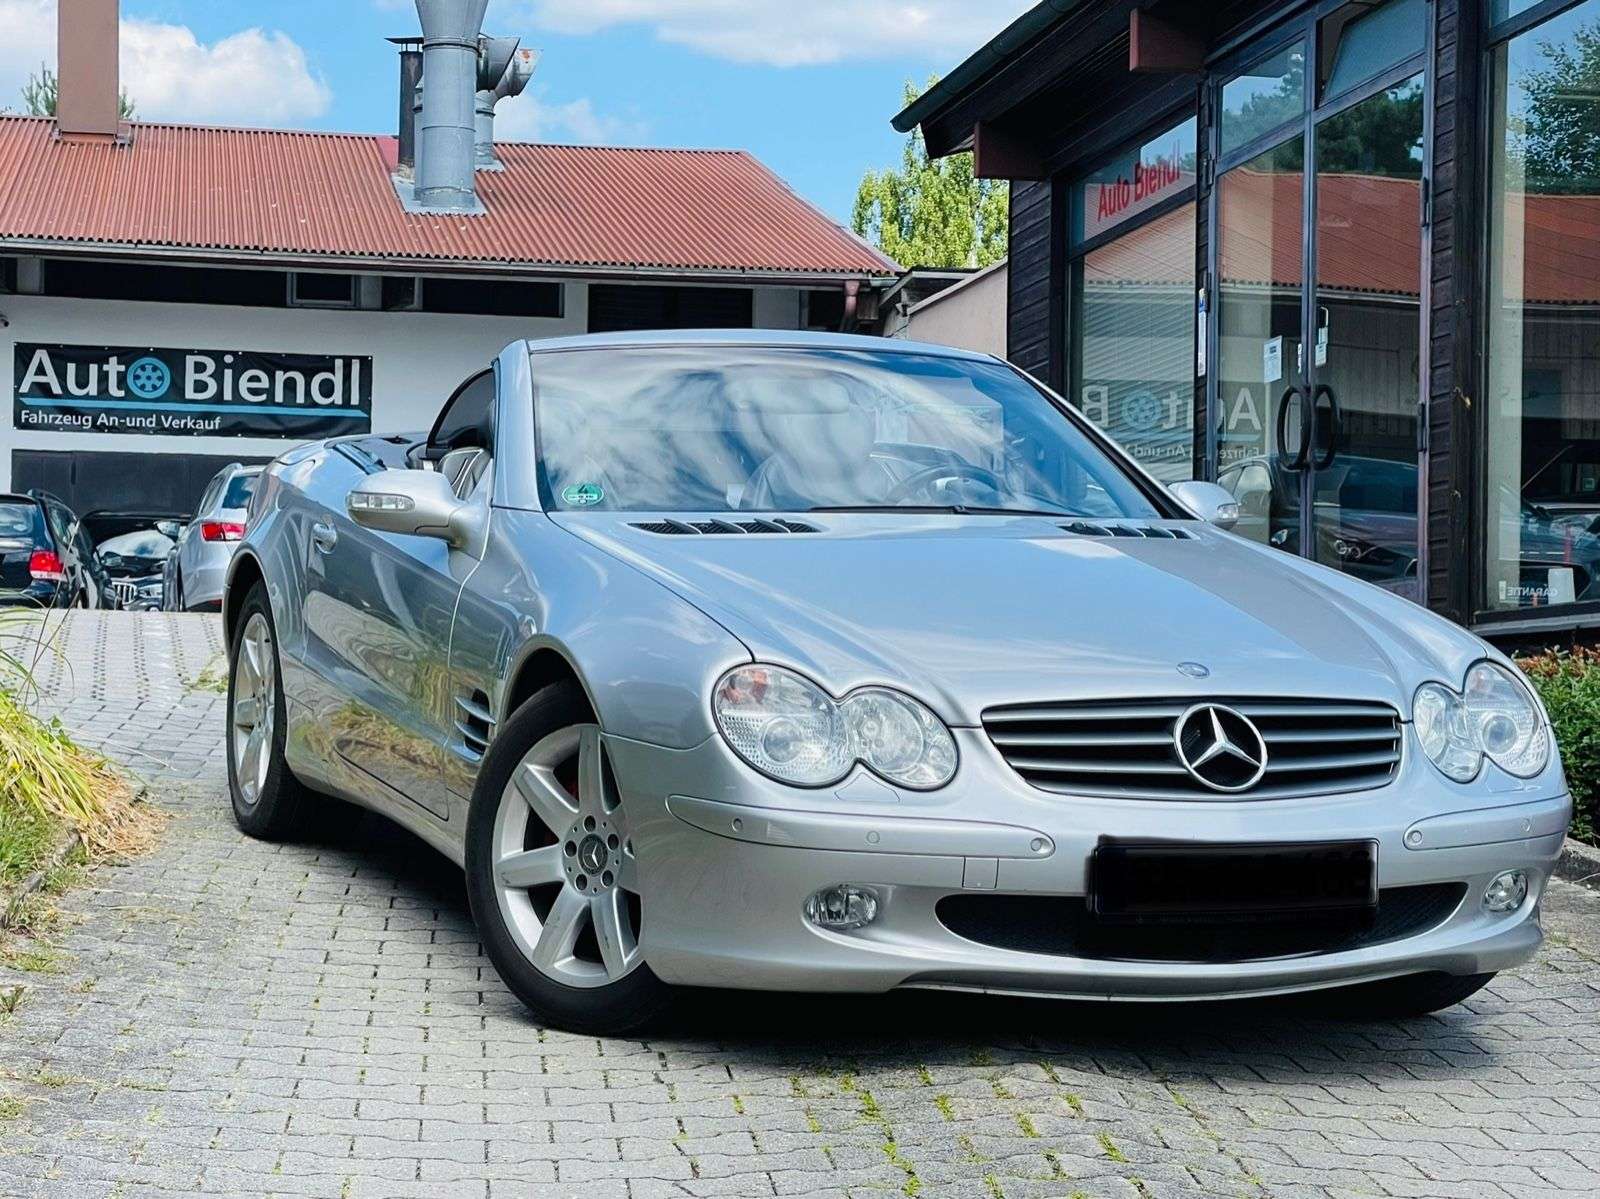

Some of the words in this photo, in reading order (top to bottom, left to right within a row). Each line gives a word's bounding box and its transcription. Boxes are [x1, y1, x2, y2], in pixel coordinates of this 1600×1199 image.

[1097, 173, 1130, 222] Auto
[1134, 140, 1180, 202] Biendl
[184, 353, 361, 406] Biendl
[20, 409, 93, 428] Fahrzeug
[96, 412, 157, 428] An-und
[161, 414, 222, 431] Verkauf
[578, 484, 589, 494] 4
